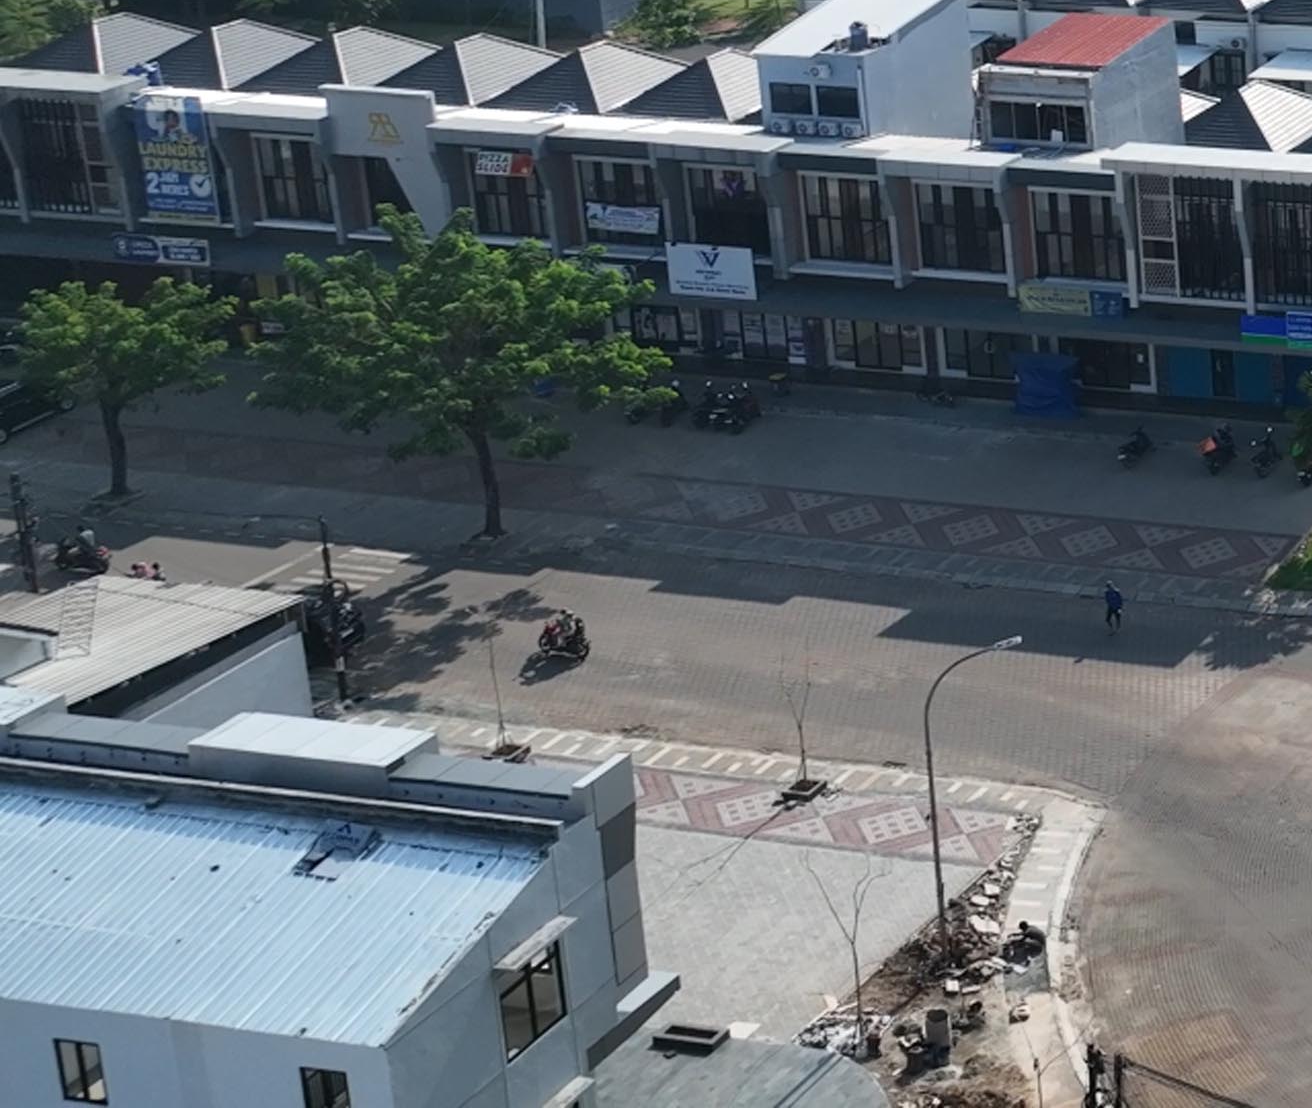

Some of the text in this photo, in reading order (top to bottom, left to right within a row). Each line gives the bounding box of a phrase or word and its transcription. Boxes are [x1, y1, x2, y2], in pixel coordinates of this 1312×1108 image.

[138, 142, 208, 158] LAUNDRY
[143, 157, 208, 173] EXPRESS
[146, 172, 160, 194] 2
